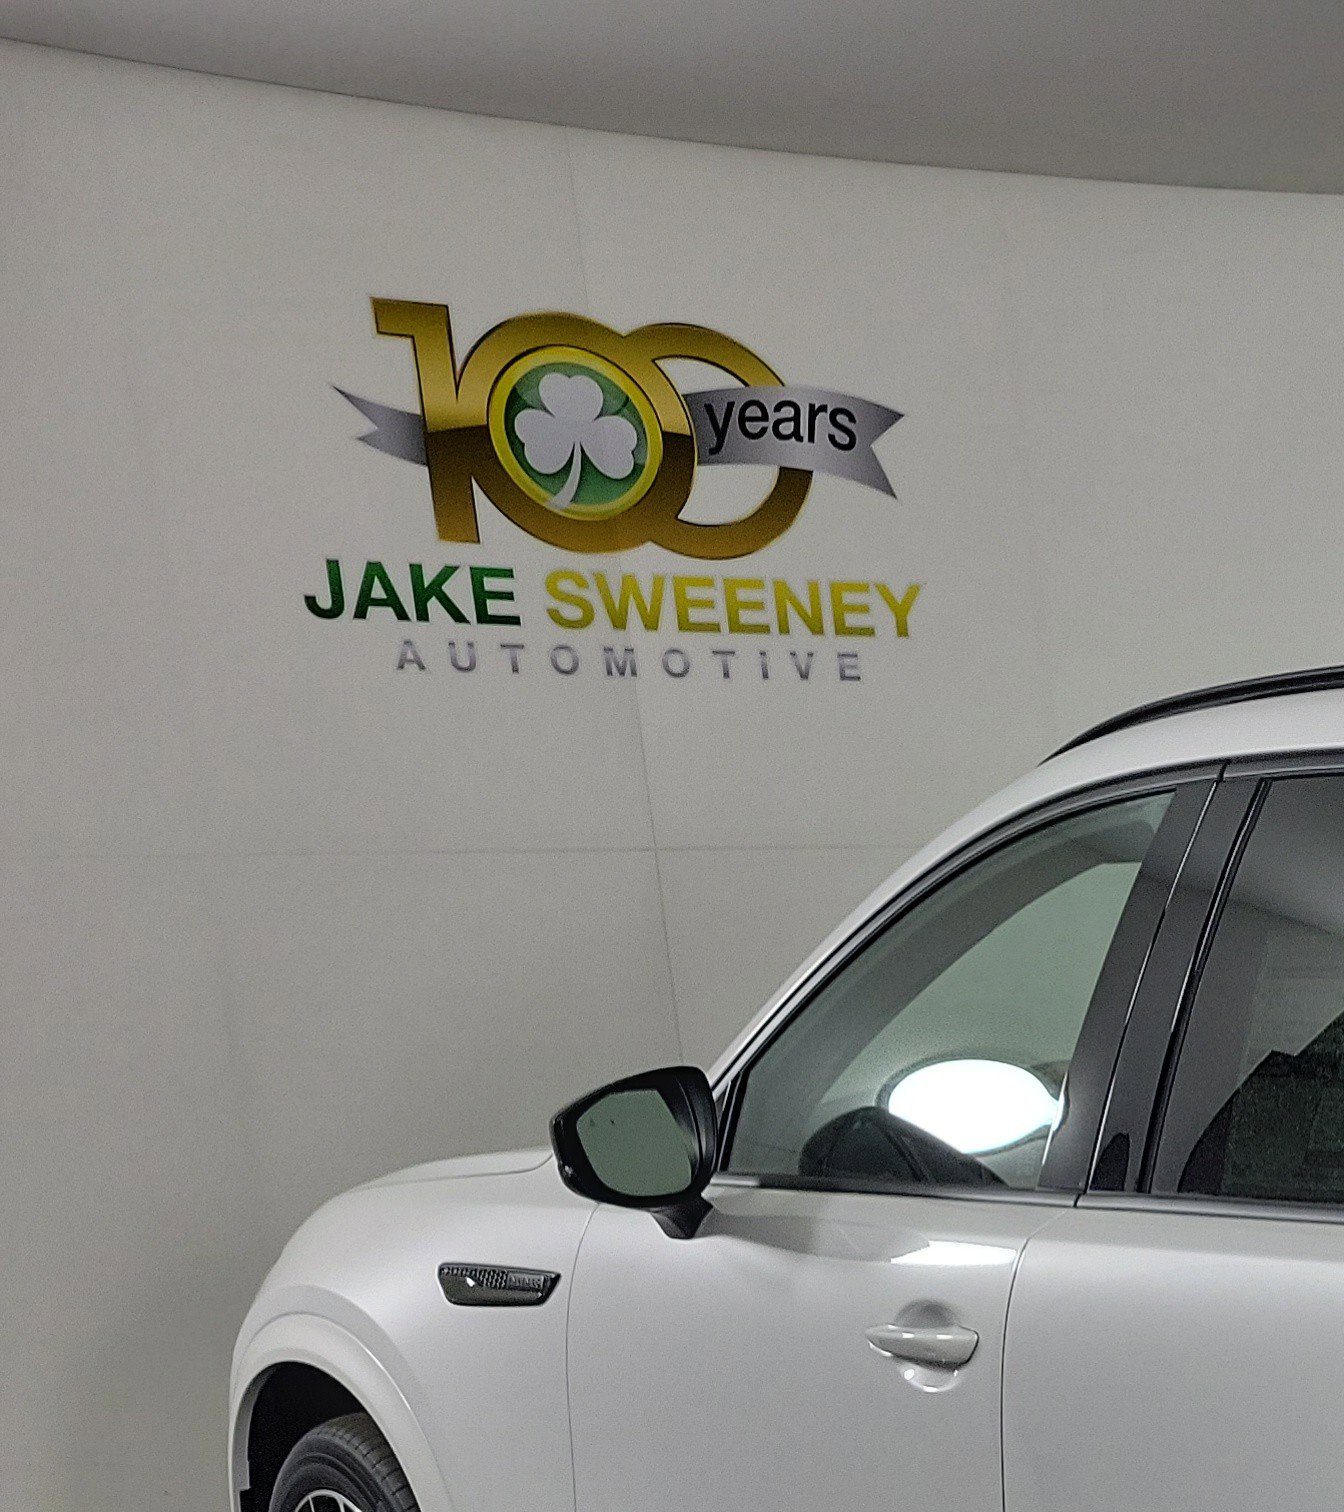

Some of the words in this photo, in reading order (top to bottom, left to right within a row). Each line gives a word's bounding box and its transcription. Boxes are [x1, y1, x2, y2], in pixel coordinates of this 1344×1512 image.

[369, 296, 814, 560] 100
[705, 398, 858, 454] years
[304, 557, 523, 627] JAKE
[545, 568, 925, 638] SWEENEY
[396, 638, 863, 682] AUTOMOTIVE
